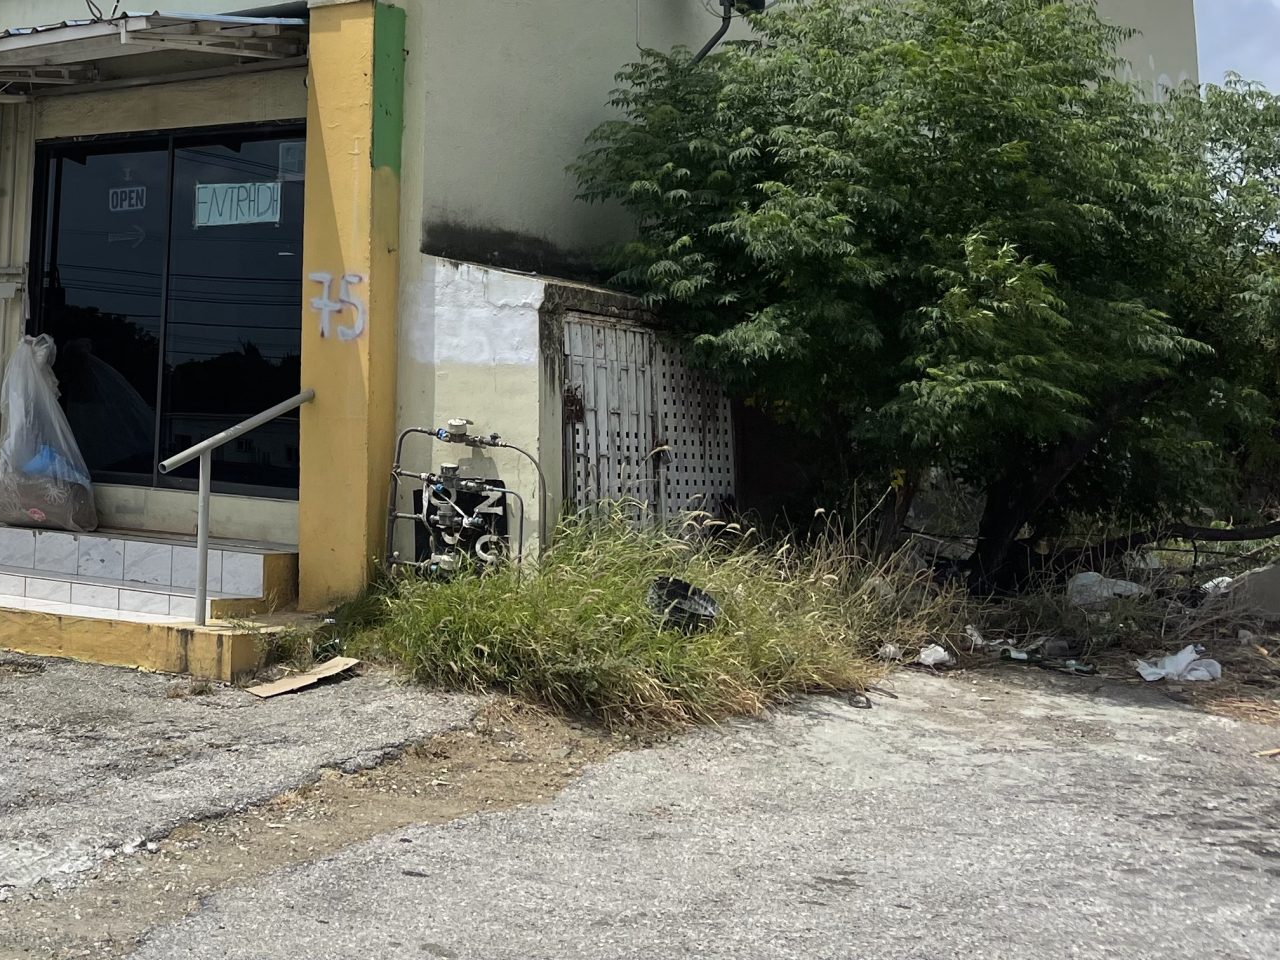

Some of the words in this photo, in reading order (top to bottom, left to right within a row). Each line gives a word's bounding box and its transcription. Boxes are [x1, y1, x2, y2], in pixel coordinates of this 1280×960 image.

[111, 188, 145, 210] OPEN
[197, 183, 279, 225] ENTRADA
[308, 271, 365, 341] 75
